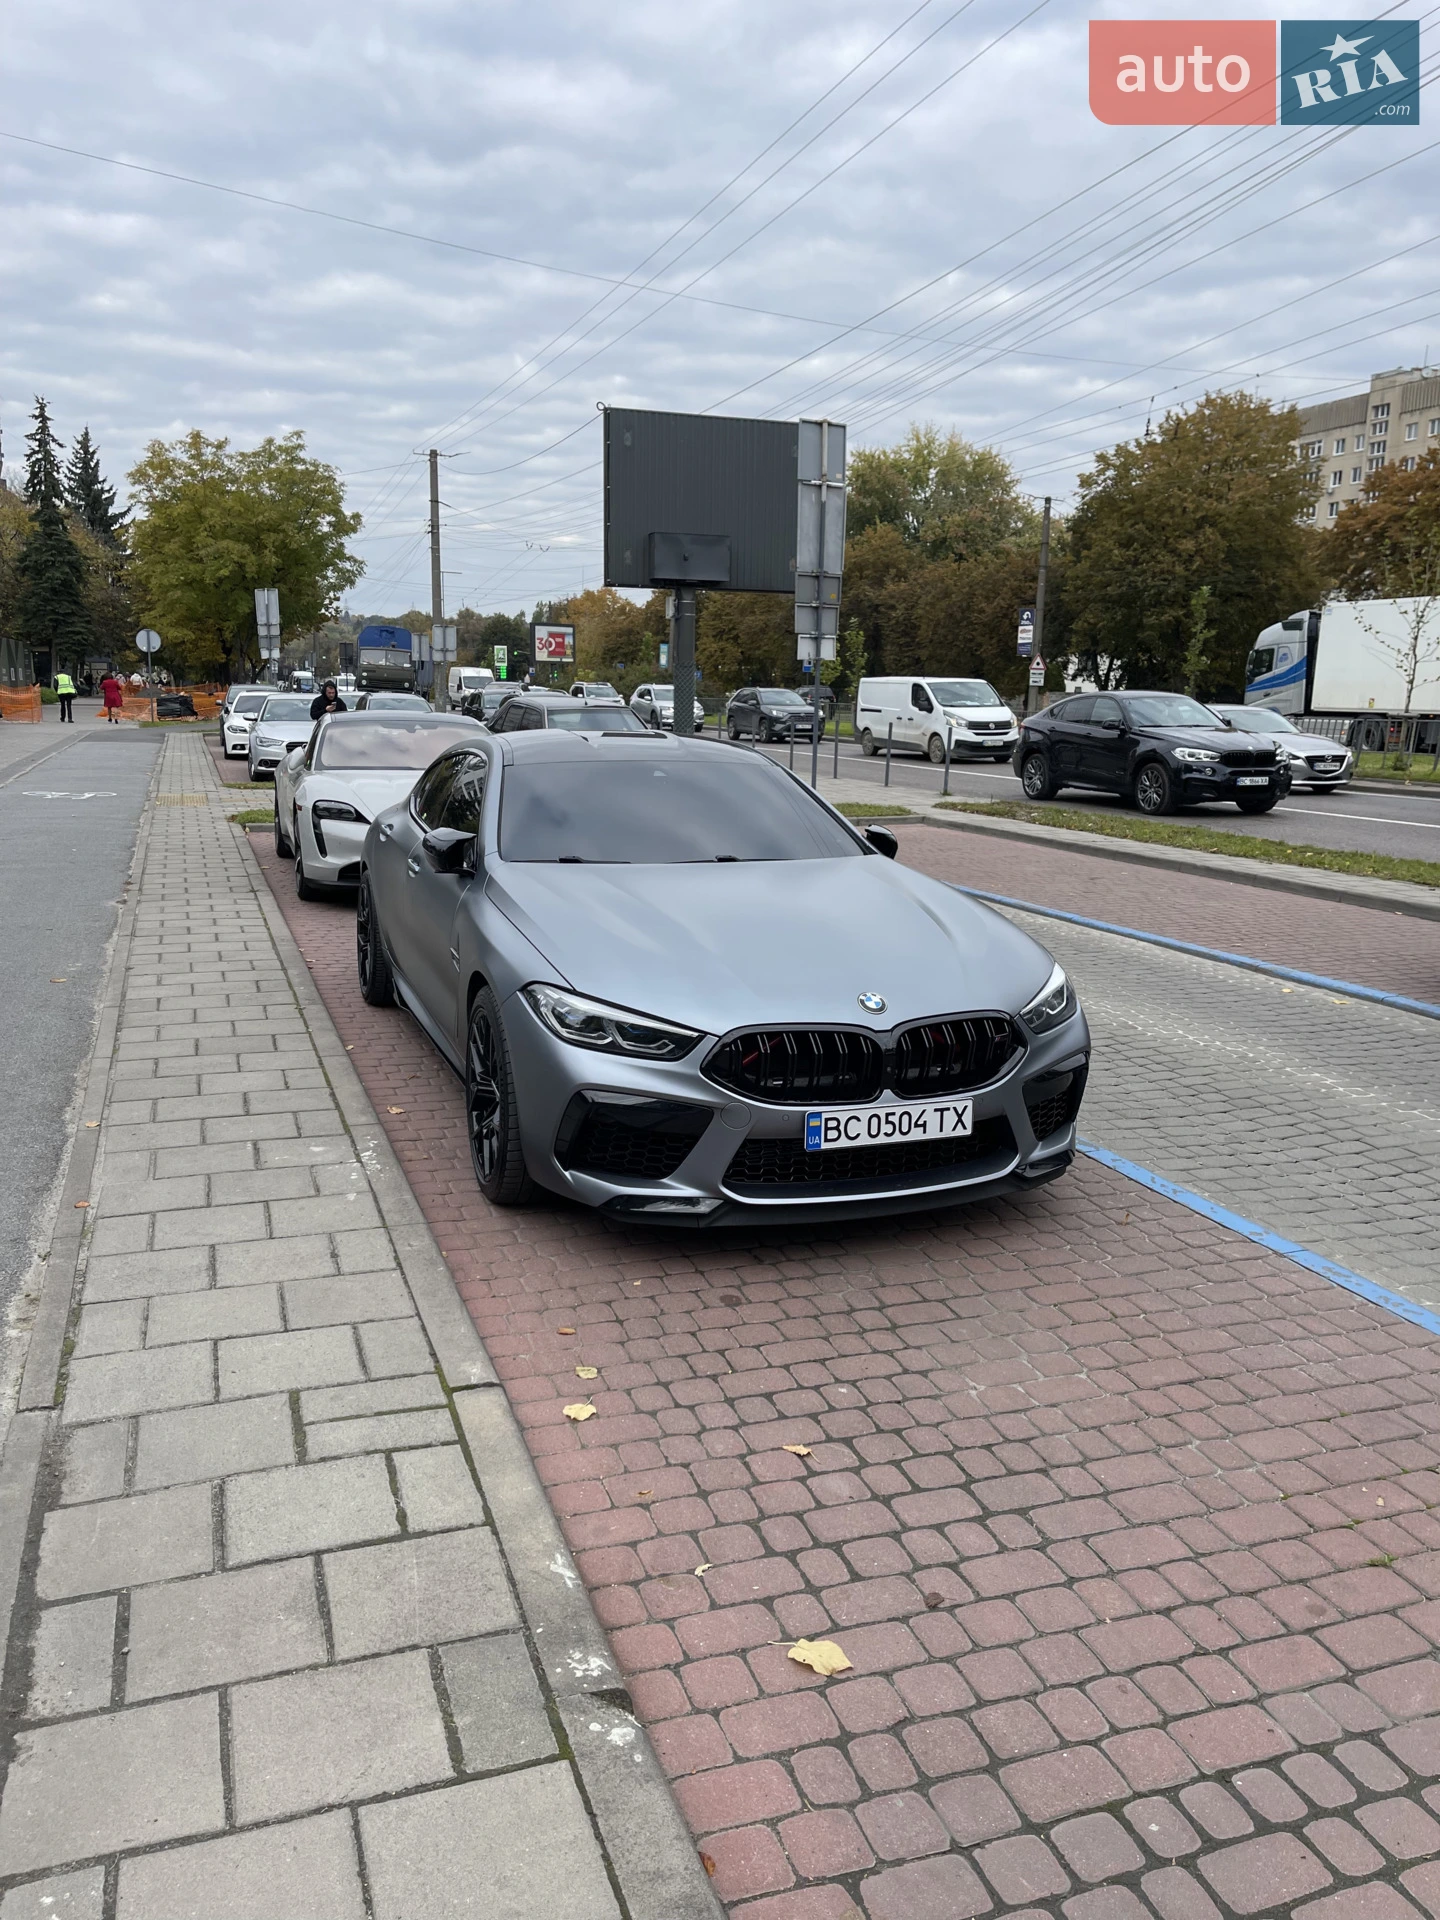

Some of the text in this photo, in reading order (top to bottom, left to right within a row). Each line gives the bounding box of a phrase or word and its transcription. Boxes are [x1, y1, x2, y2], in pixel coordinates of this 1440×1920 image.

[536, 637, 556, 652] 30
[823, 1104, 969, 1143] BC 0504 TX
[808, 1136, 820, 1145] UA
